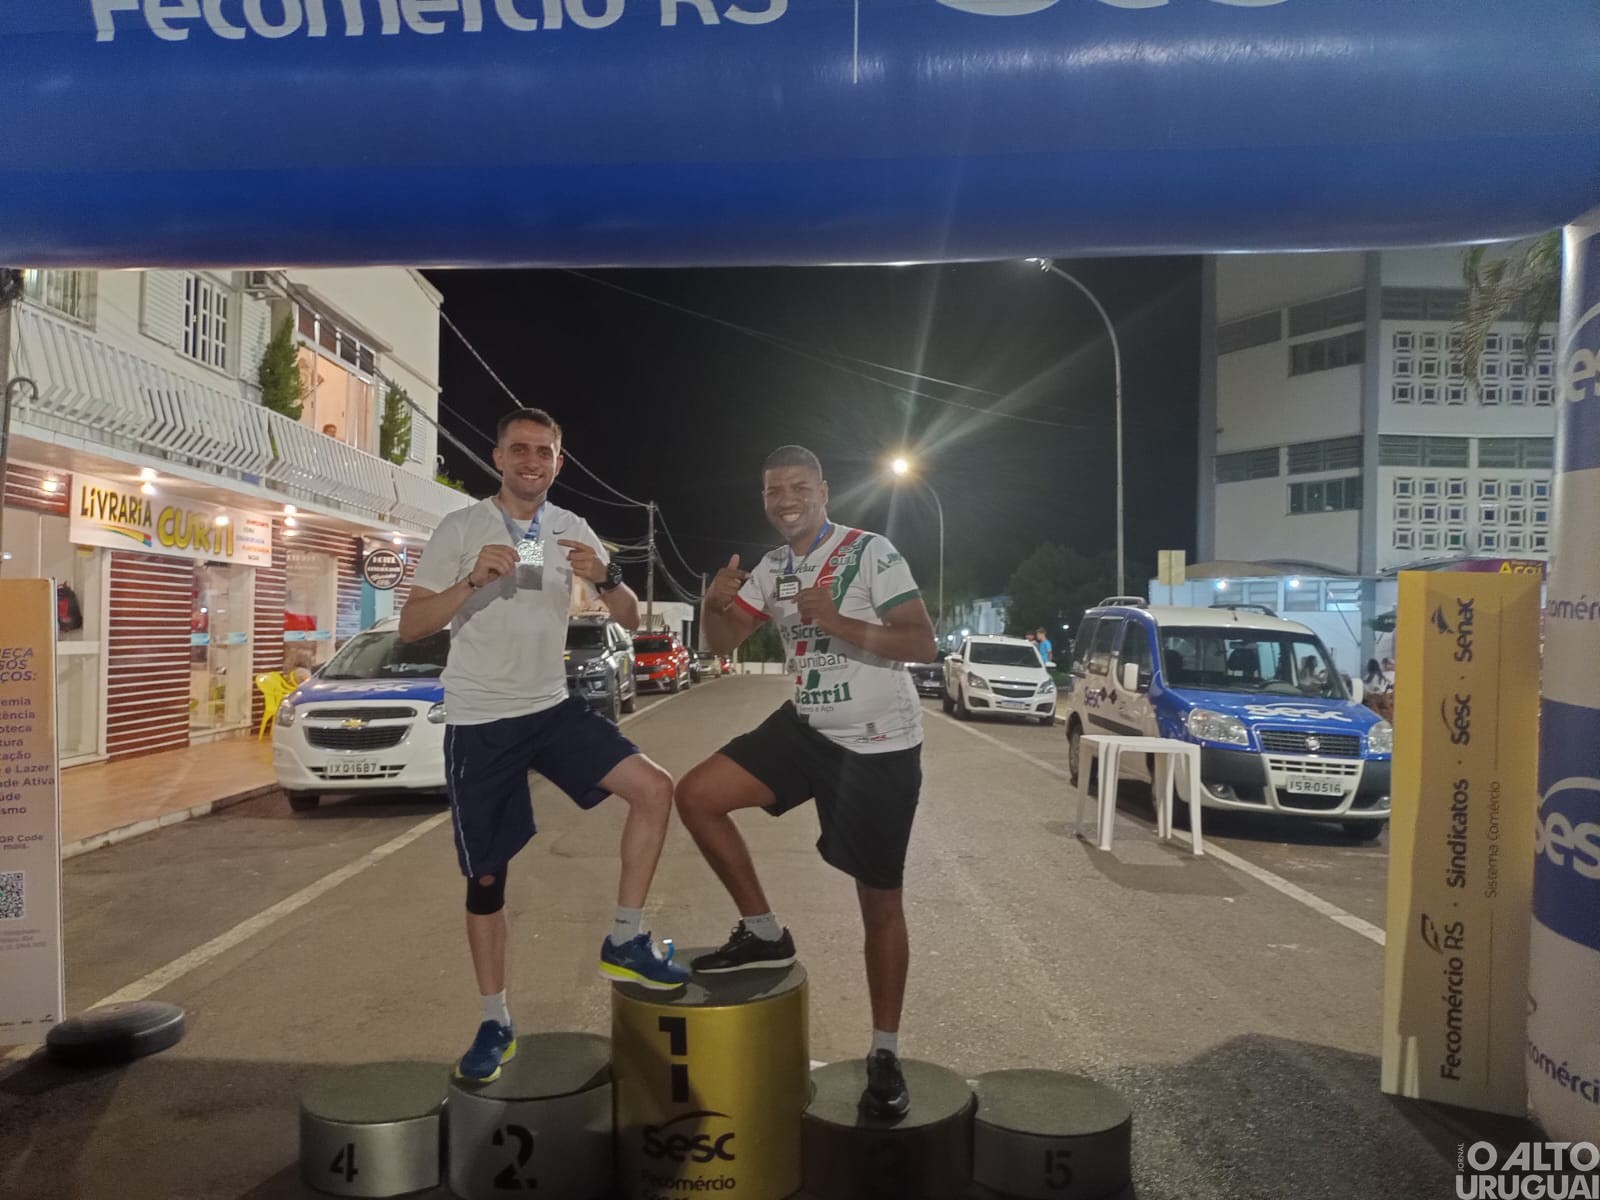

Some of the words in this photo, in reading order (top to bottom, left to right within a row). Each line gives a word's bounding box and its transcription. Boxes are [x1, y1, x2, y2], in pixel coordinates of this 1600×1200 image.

[157, 506, 234, 557] CURTI
[1548, 594, 1600, 621] omér
[791, 624, 826, 640] Sicre
[1454, 598, 1475, 662] Senac
[0, 648, 34, 660] EÇA
[1451, 694, 1471, 747] Sesc
[16, 764, 49, 774] Lazer
[23, 776, 55, 787] Ativa
[1486, 781, 1500, 841] Comércio
[17, 833, 43, 842] Code
[1447, 778, 1468, 889] Sindicatos
[1485, 844, 1498, 899] Sistema
[1444, 921, 1465, 950] RS
[1441, 956, 1464, 1081] Fecomércio
[658, 1016, 689, 1103] 1
[329, 1143, 359, 1182] 4
[642, 1123, 736, 1163] Sesc
[1044, 1150, 1073, 1190] 5
